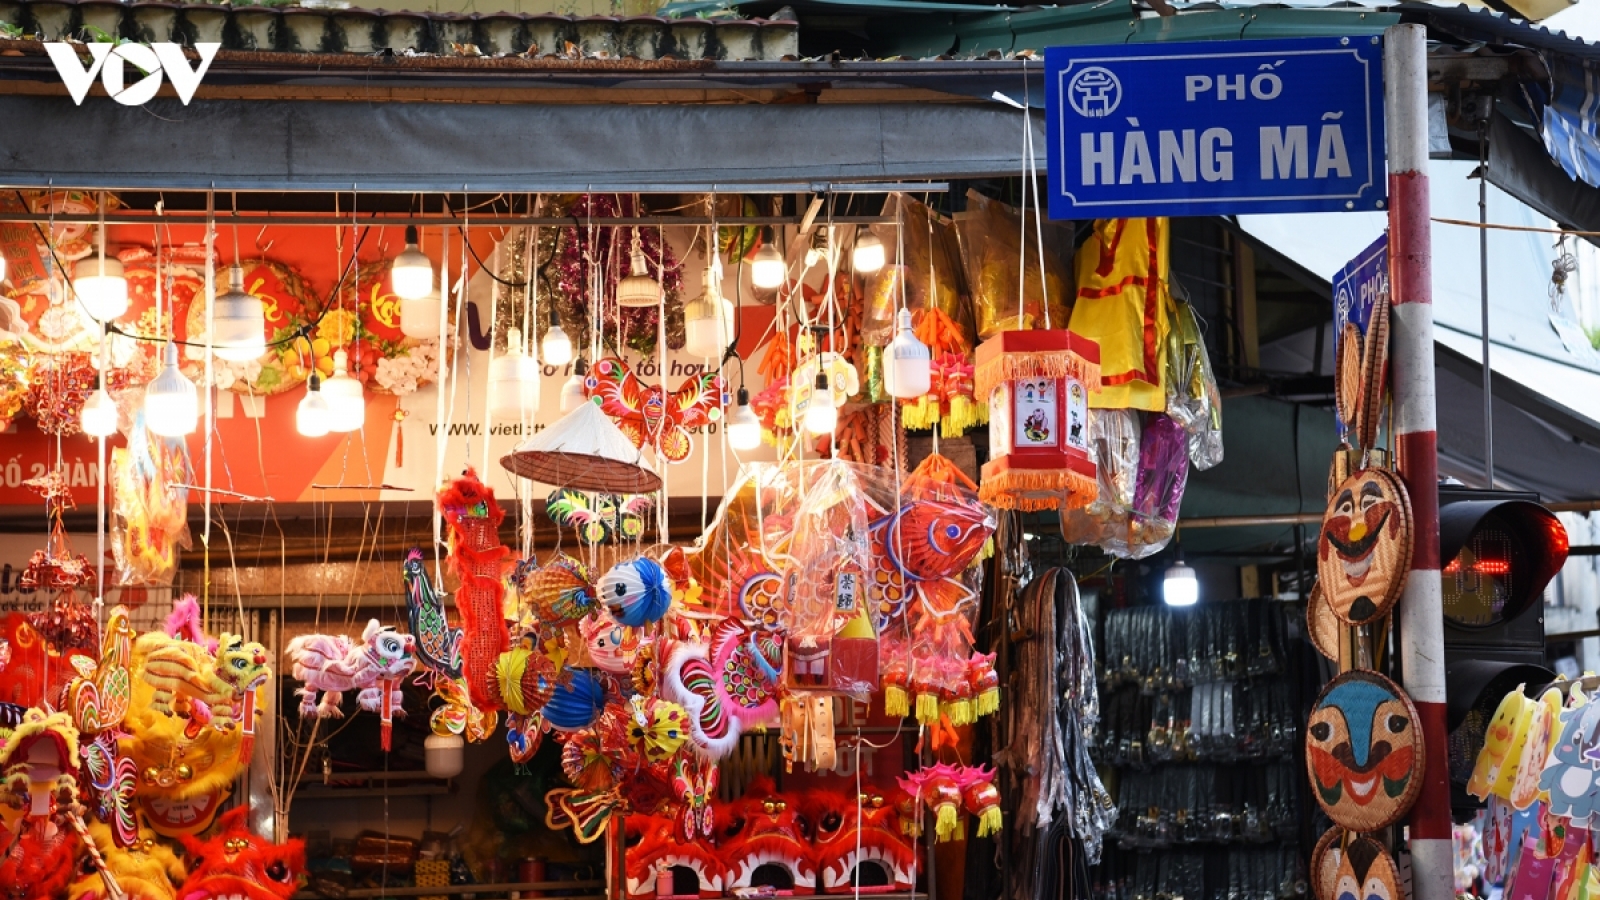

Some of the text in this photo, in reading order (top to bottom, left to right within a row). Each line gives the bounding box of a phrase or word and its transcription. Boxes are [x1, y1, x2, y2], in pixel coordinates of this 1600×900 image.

[1185, 60, 1286, 101] PHỐ
[1080, 111, 1352, 186] HÀNG MÃ
[1361, 256, 1384, 309] PHỐ
[53, 456, 114, 488] HÀN
